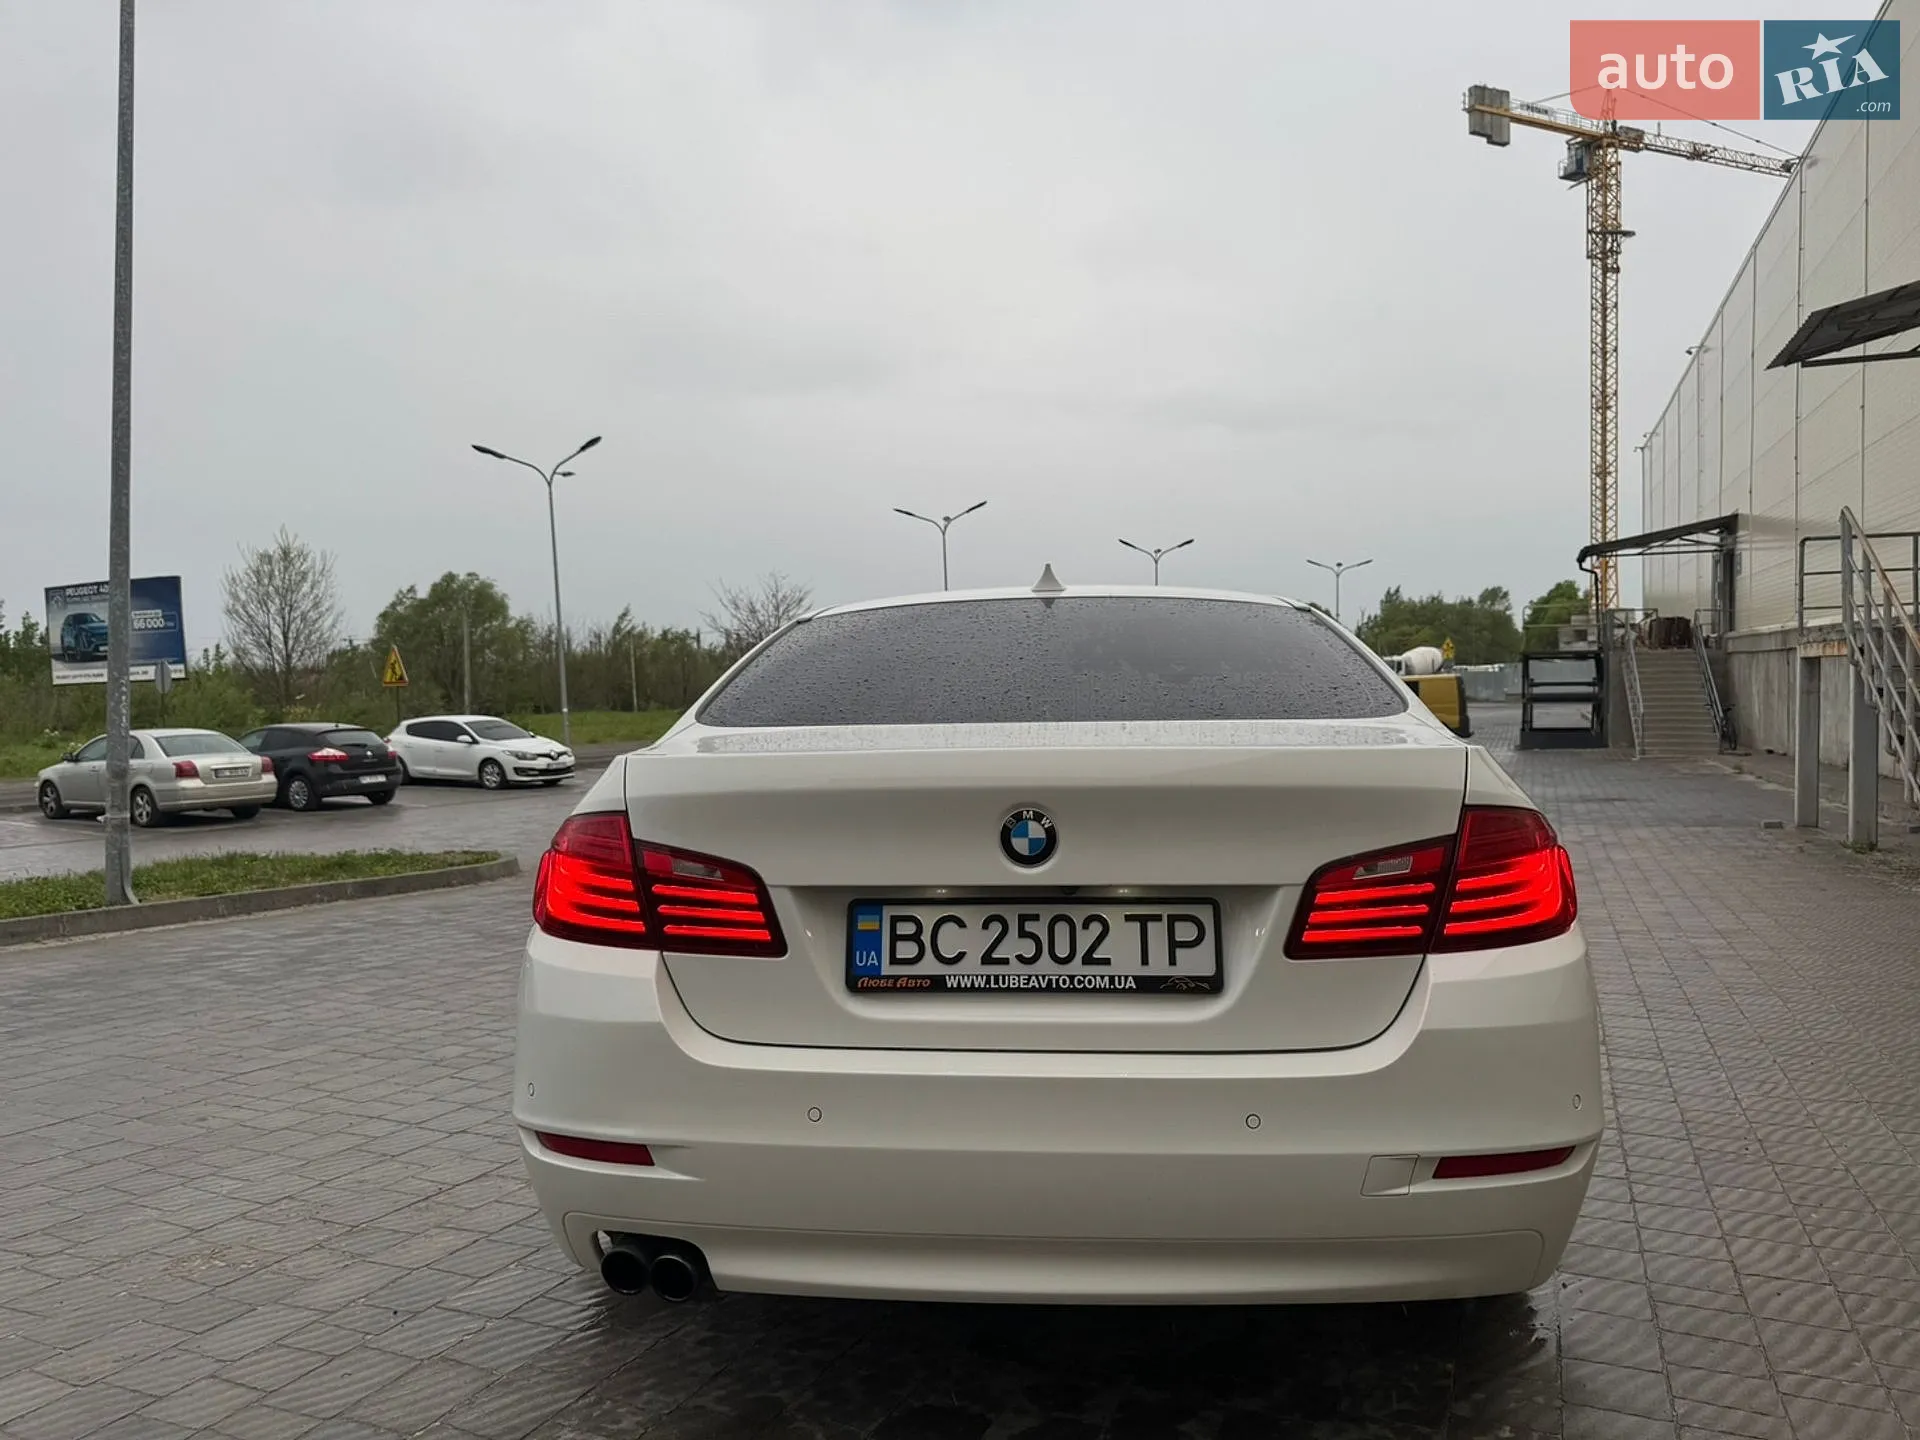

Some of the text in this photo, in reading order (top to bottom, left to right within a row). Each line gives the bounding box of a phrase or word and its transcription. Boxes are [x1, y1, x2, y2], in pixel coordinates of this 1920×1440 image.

[1005, 810, 1054, 829] BMW
[889, 913, 1206, 967] BC 2502 TP
[856, 951, 879, 967] UA
[945, 975, 1137, 989] WWW.LUBEAVTO.COM.UA
